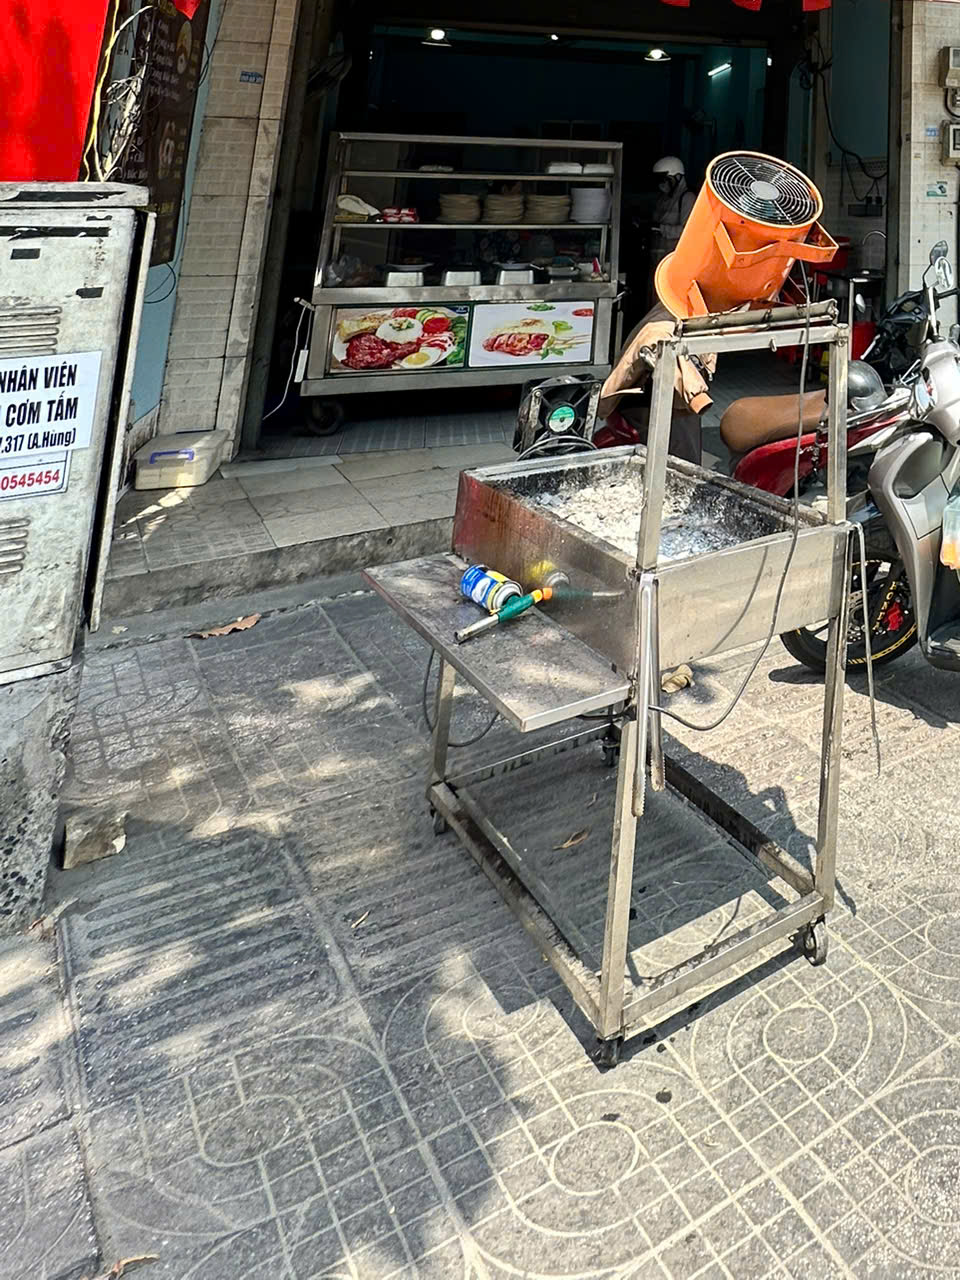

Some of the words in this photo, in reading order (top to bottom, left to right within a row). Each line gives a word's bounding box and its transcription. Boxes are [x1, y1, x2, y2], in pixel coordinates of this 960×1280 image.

[0, 365, 39, 394] NHÂN
[44, 361, 78, 390] VIÊN
[5, 398, 42, 428] CƠM
[47, 390, 79, 423] TẤM
[0, 469, 60, 491] 0545454
